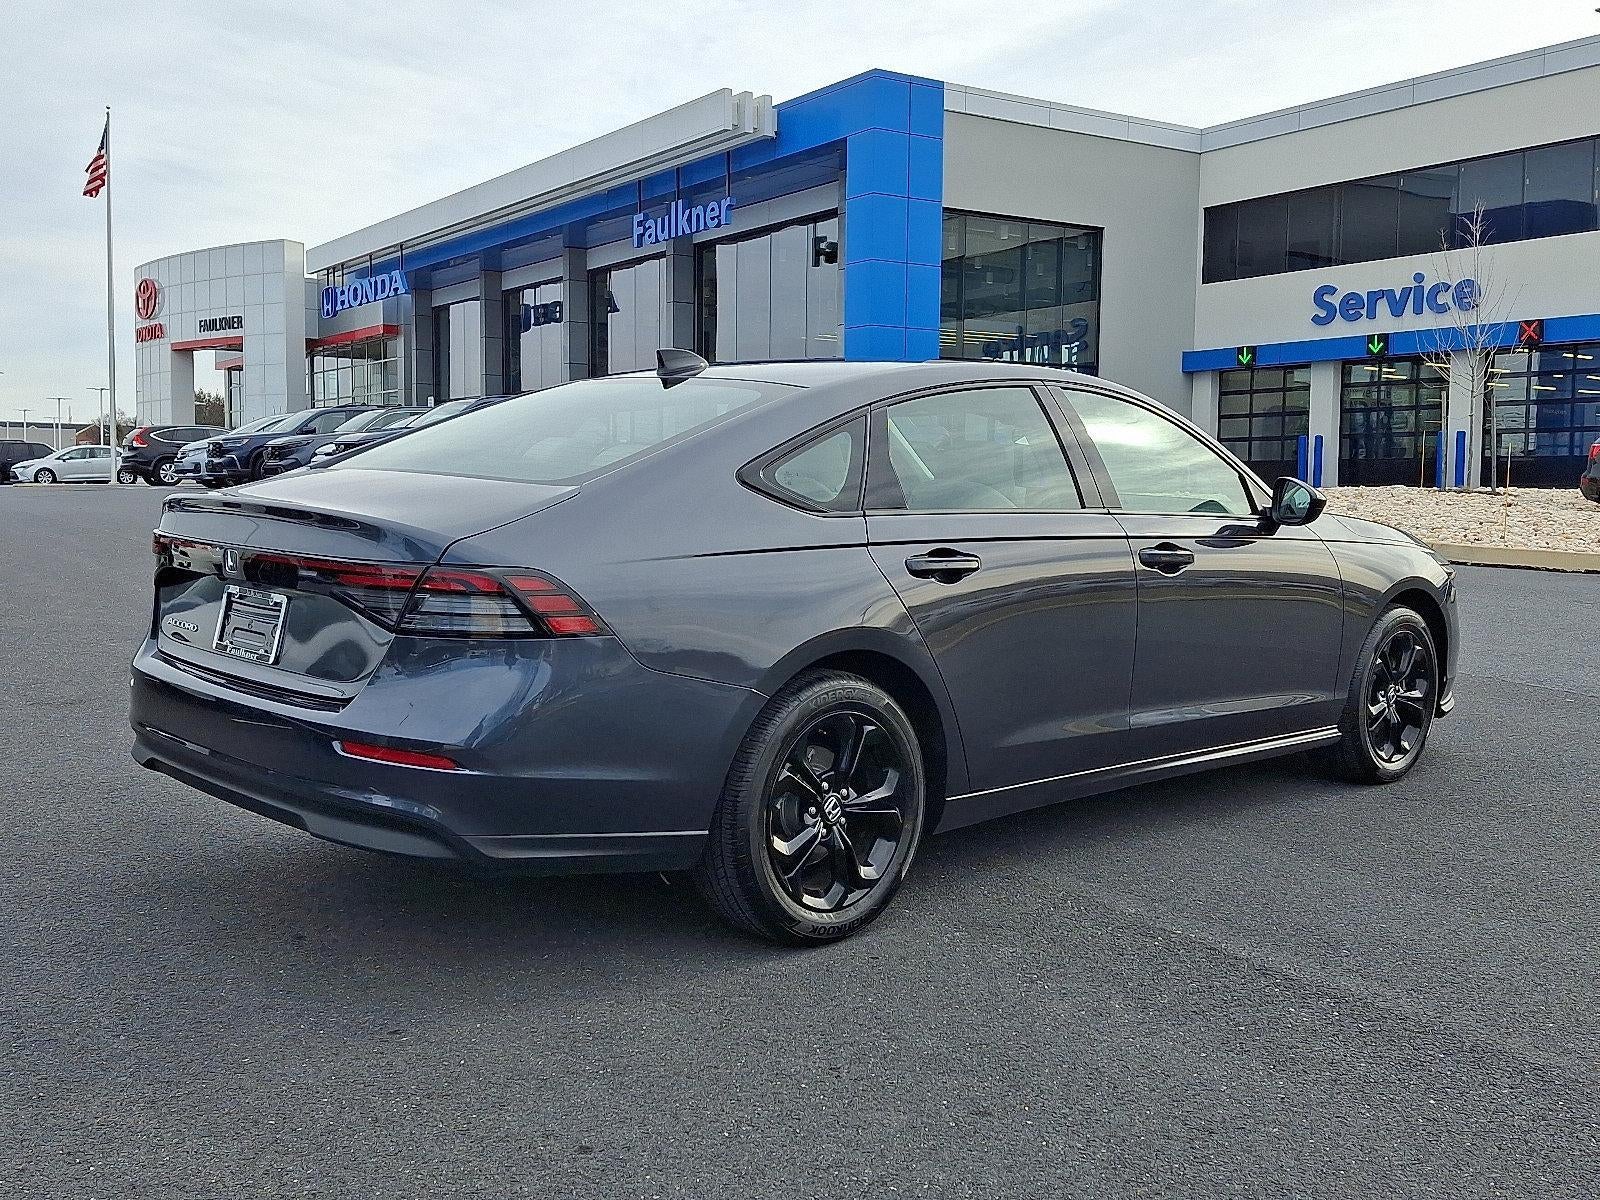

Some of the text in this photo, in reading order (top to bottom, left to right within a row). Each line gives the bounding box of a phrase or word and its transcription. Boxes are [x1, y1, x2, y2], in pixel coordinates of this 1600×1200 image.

[633, 196, 735, 249] Faulkner
[335, 270, 407, 311] HONDA
[1311, 272, 1482, 326] Service
[199, 316, 243, 333] FAULKNER
[167, 617, 198, 632] ACCORD
